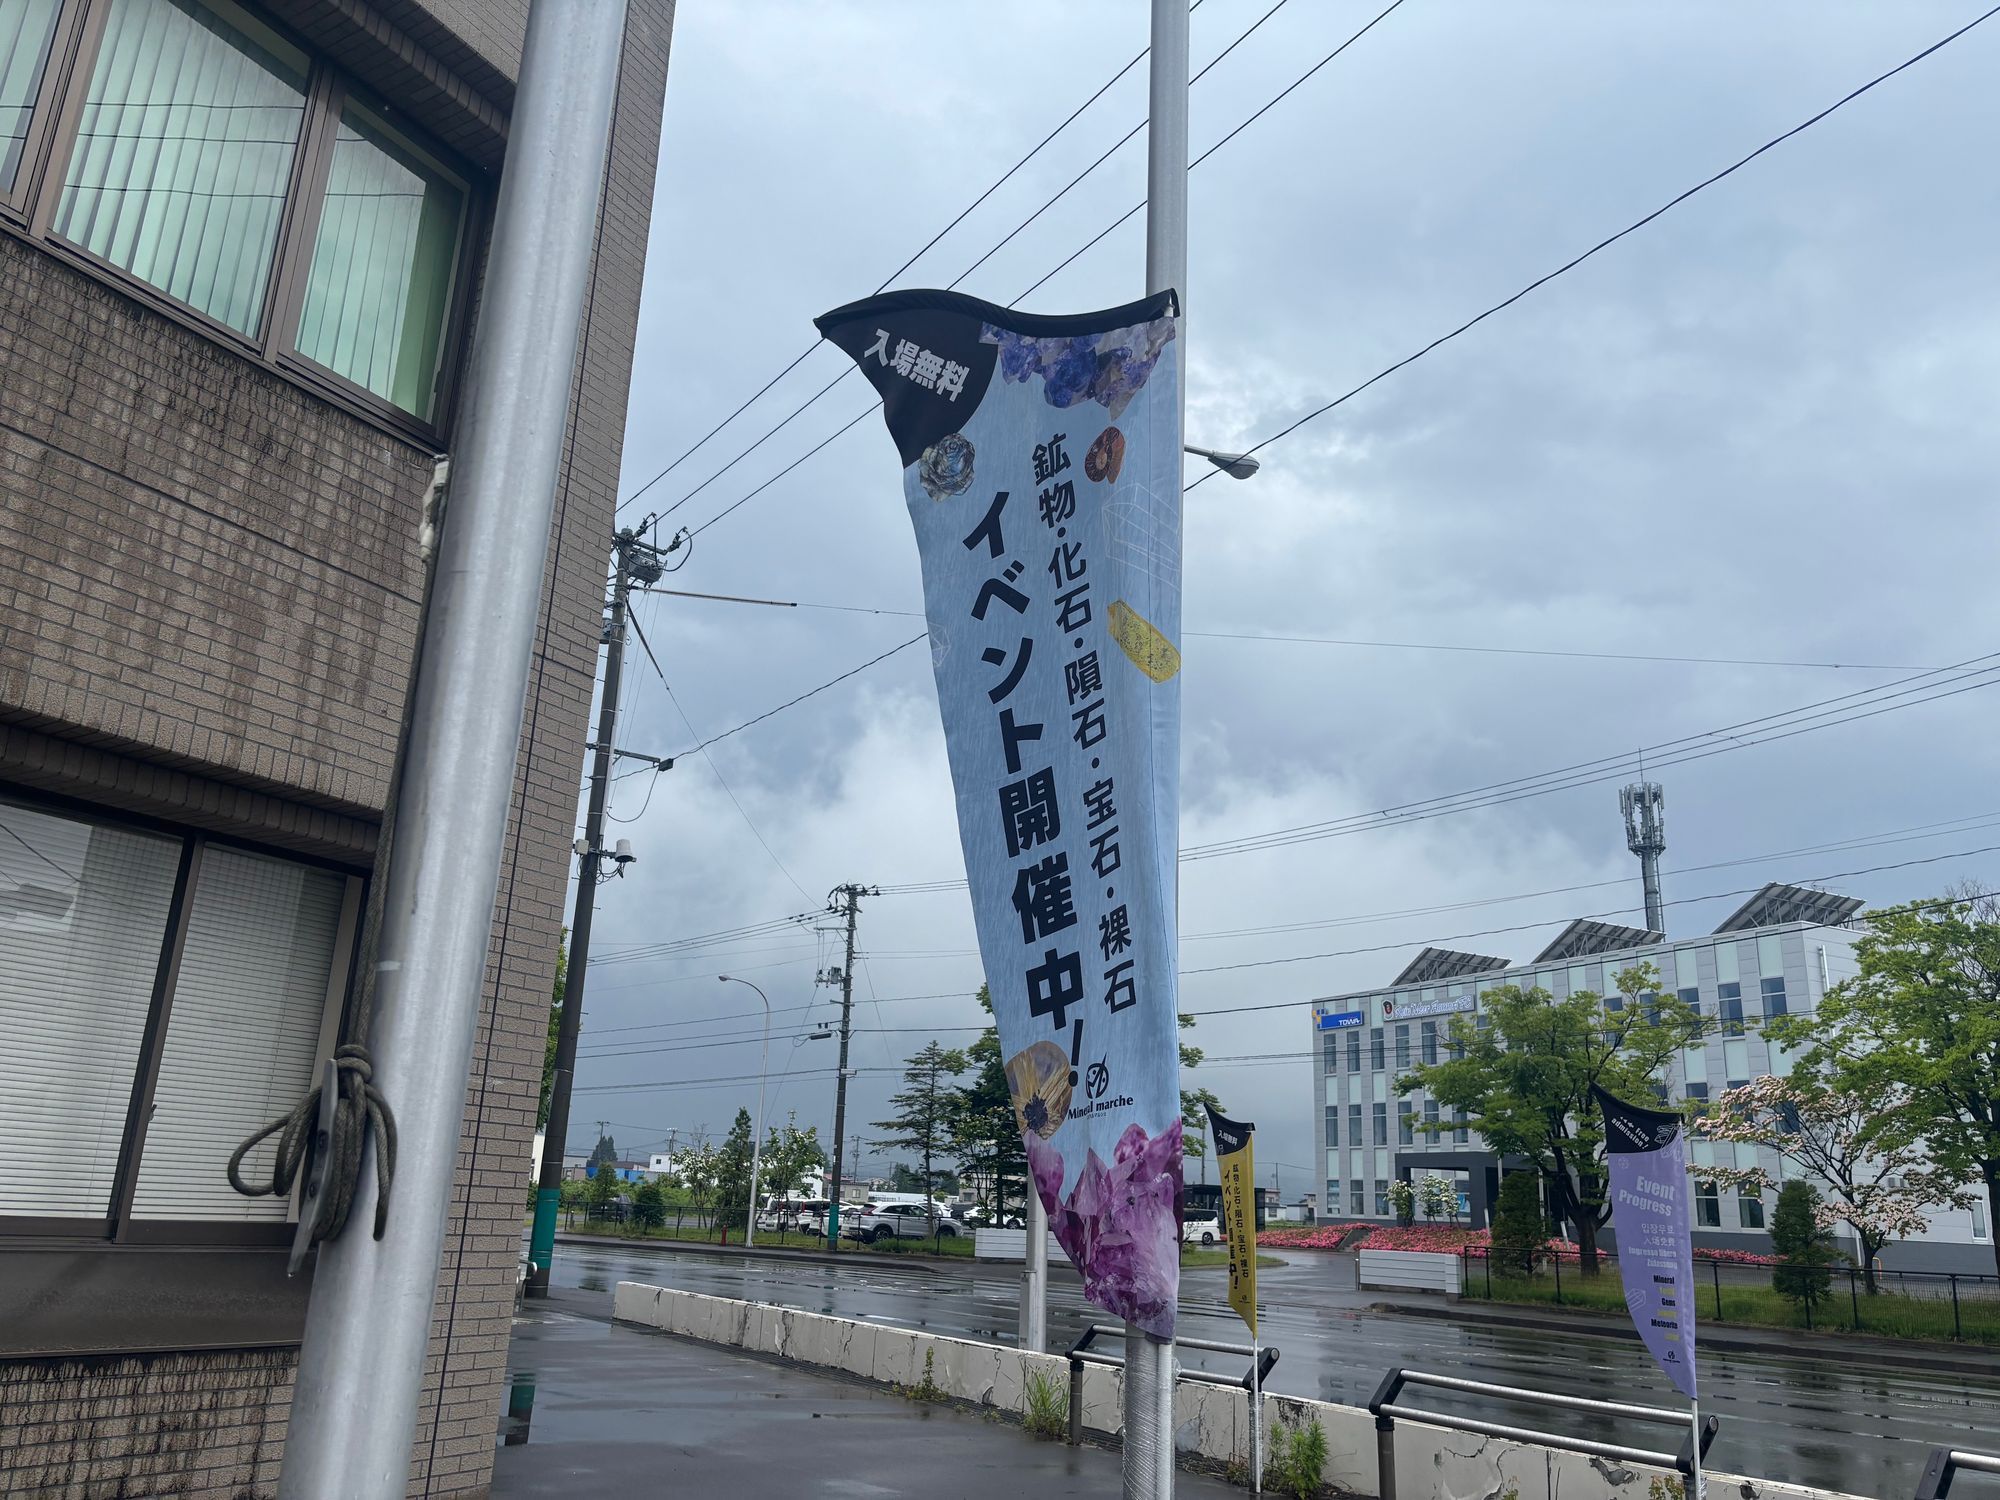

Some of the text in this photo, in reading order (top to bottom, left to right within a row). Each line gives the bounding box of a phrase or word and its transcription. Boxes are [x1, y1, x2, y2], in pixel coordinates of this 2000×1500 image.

[864, 328, 970, 402] 入場無料
[1032, 433, 1137, 1015] 鉱物・化石・隕石・宝石・裸石
[1068, 1100, 1093, 1120] Mineal
[1096, 1094, 1134, 1111] marche
[1635, 1127, 1650, 1142] Free
[1636, 1175, 1676, 1201] Event
[1618, 1189, 1673, 1217] Progress
